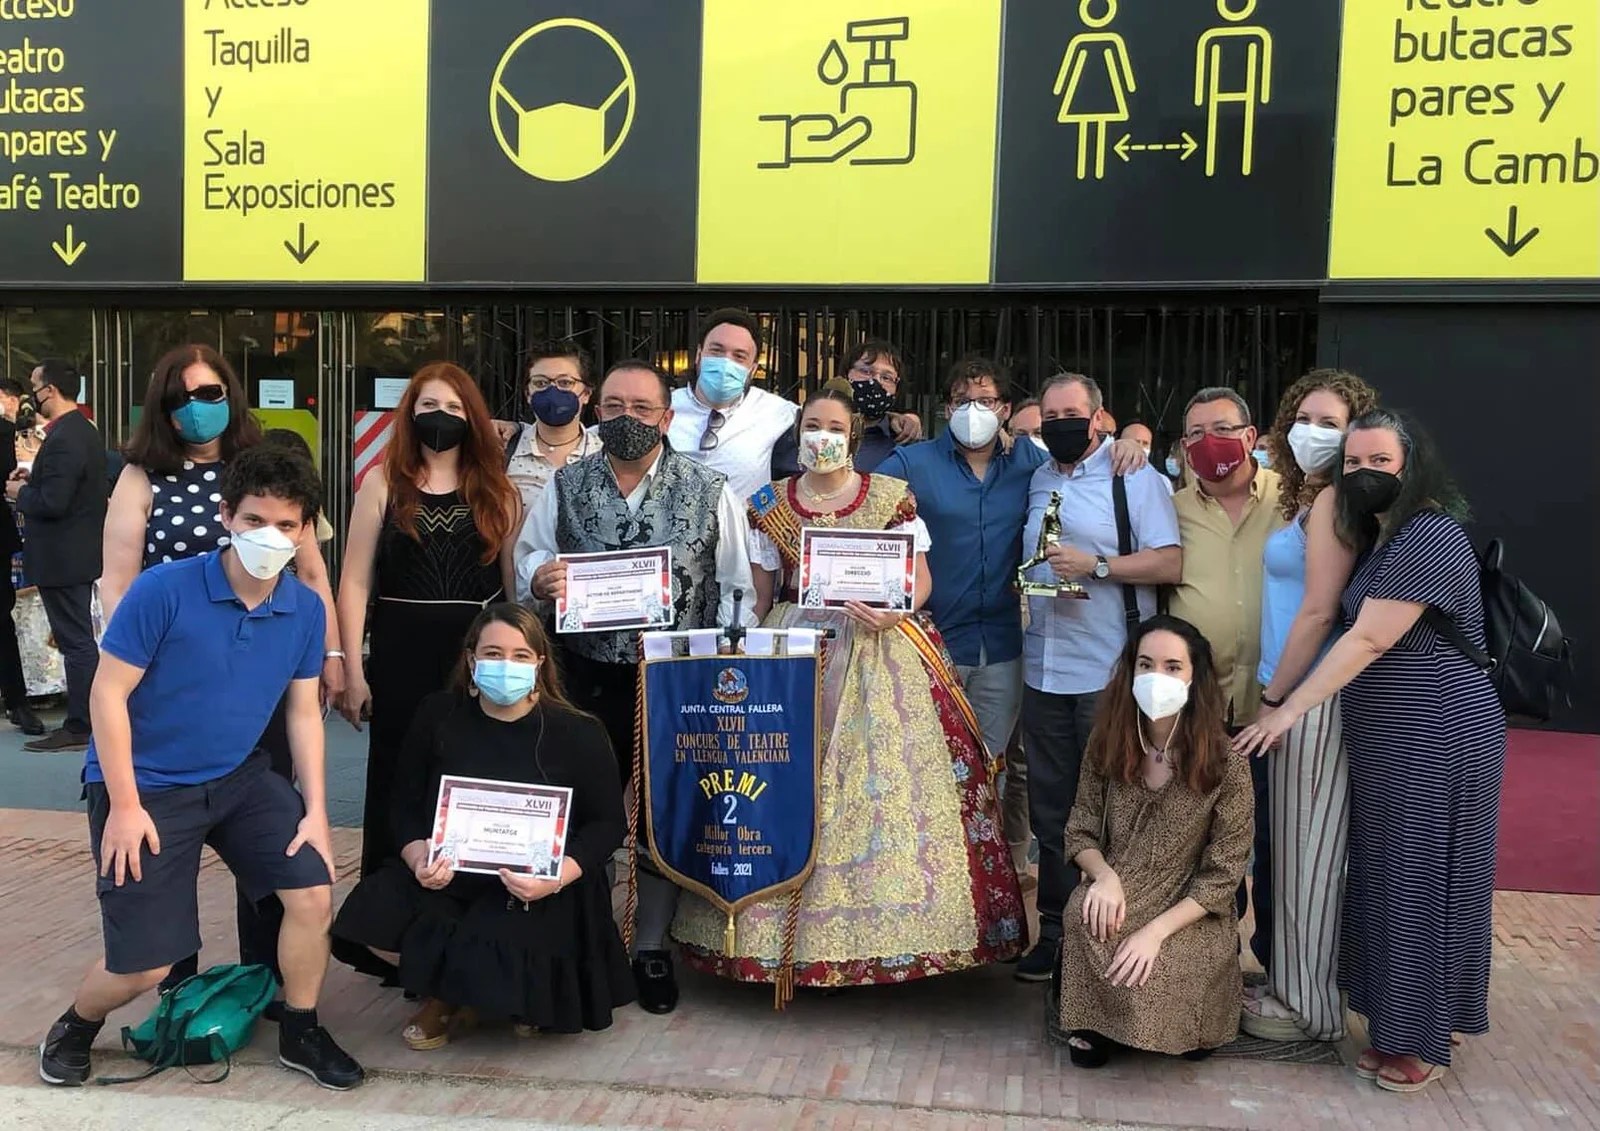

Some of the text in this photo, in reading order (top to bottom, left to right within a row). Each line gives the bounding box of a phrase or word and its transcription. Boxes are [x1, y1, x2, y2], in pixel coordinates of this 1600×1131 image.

[204, 27, 311, 72] Taquilla
[1394, 15, 1574, 63] butacas
[205, 86, 223, 118] y
[1390, 81, 1565, 127] pares y
[98, 129, 117, 163] y
[204, 129, 265, 166] Sala
[1387, 141, 1442, 186] La
[49, 172, 141, 210] Teatro
[204, 173, 396, 216] Exposiciones
[876, 543, 901, 553] XLVII
[632, 559, 656, 569] XLVII
[680, 703, 783, 714] JUNTA CENTRAL FALLERA
[717, 716, 745, 732] XLVII
[675, 750, 790, 764] EN LLENGUA VALENCIANA
[676, 733, 789, 750] CONCURS DE TEATRE
[699, 769, 768, 802] PREMI
[525, 798, 552, 811] XLVII
[722, 794, 738, 825] 2
[737, 825, 761, 842] Obra
[739, 842, 772, 856] tercera
[733, 862, 752, 876] 2021
